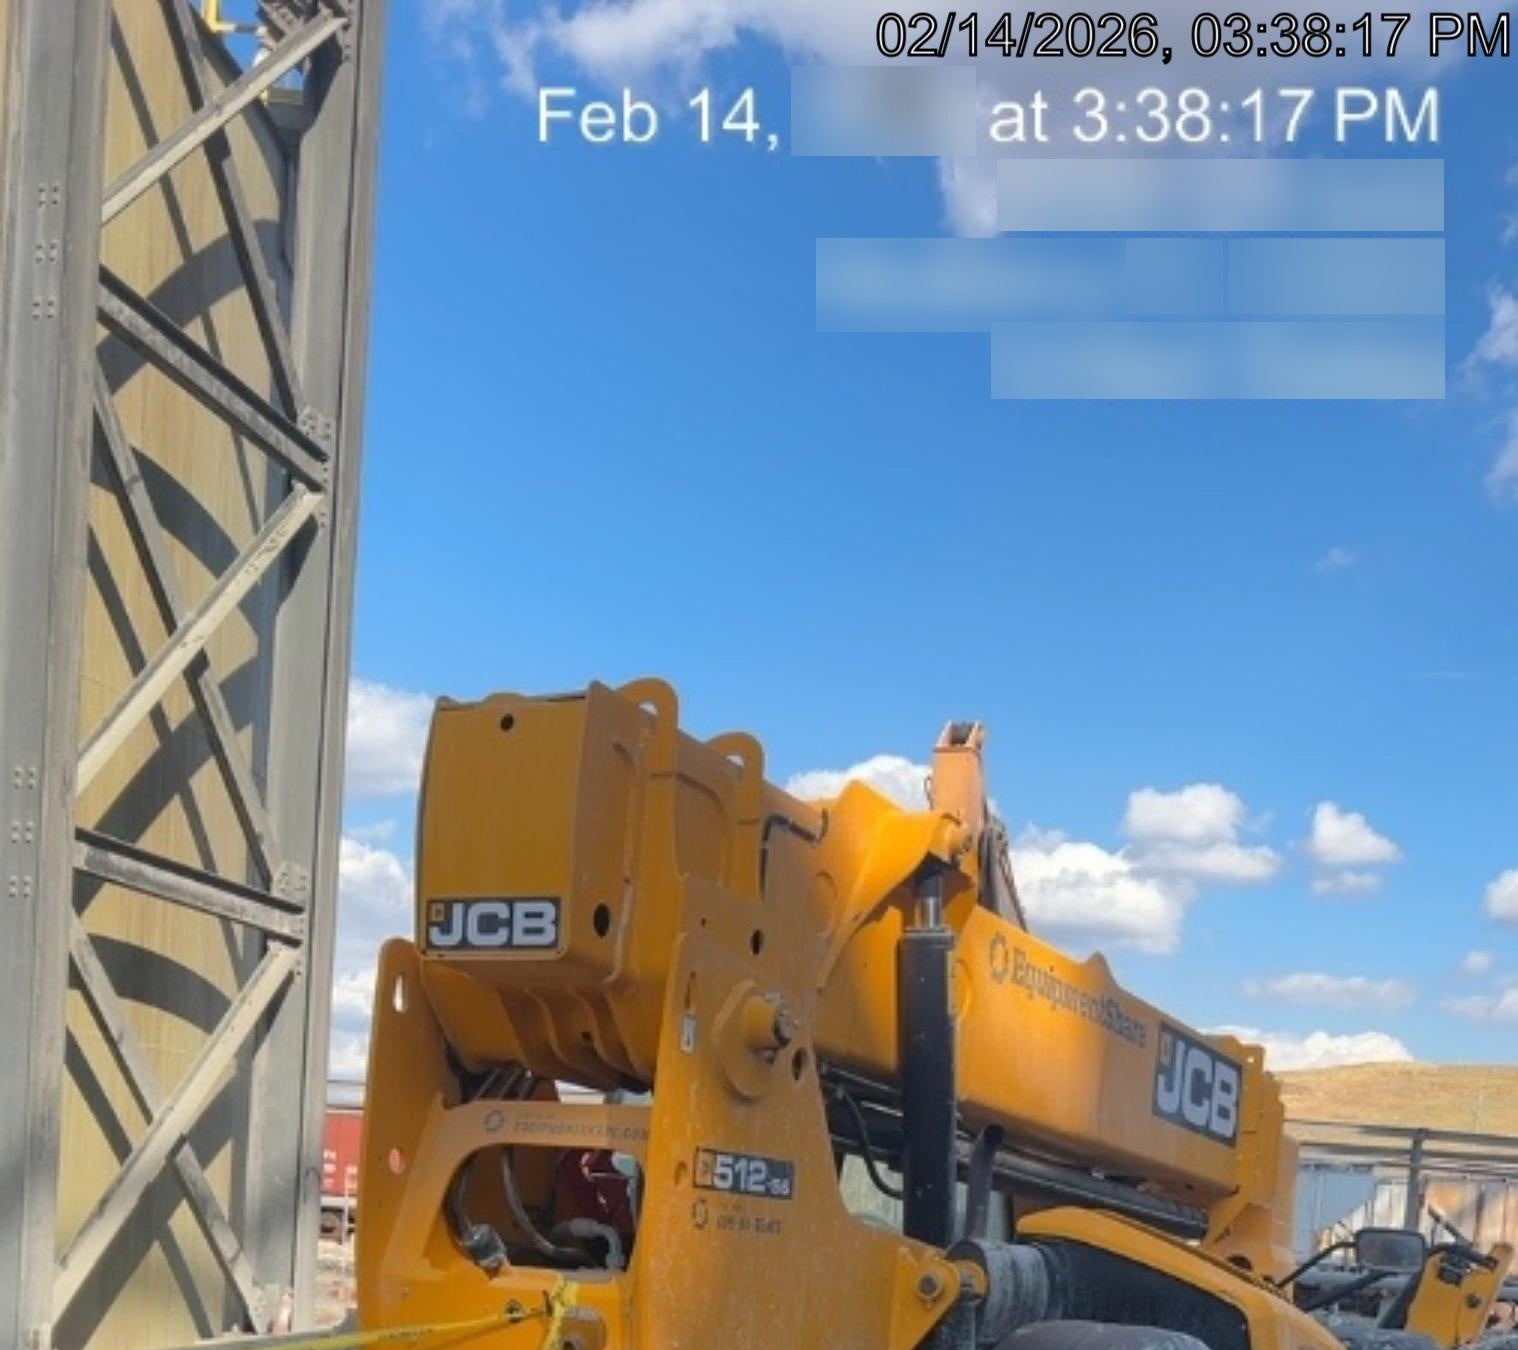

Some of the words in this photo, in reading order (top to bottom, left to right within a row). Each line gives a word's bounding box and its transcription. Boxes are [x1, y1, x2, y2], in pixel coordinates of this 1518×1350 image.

[429, 901, 557, 947] JCB
[1011, 947, 1147, 1049] EquipmentShare
[1157, 1038, 1238, 1139] JCB
